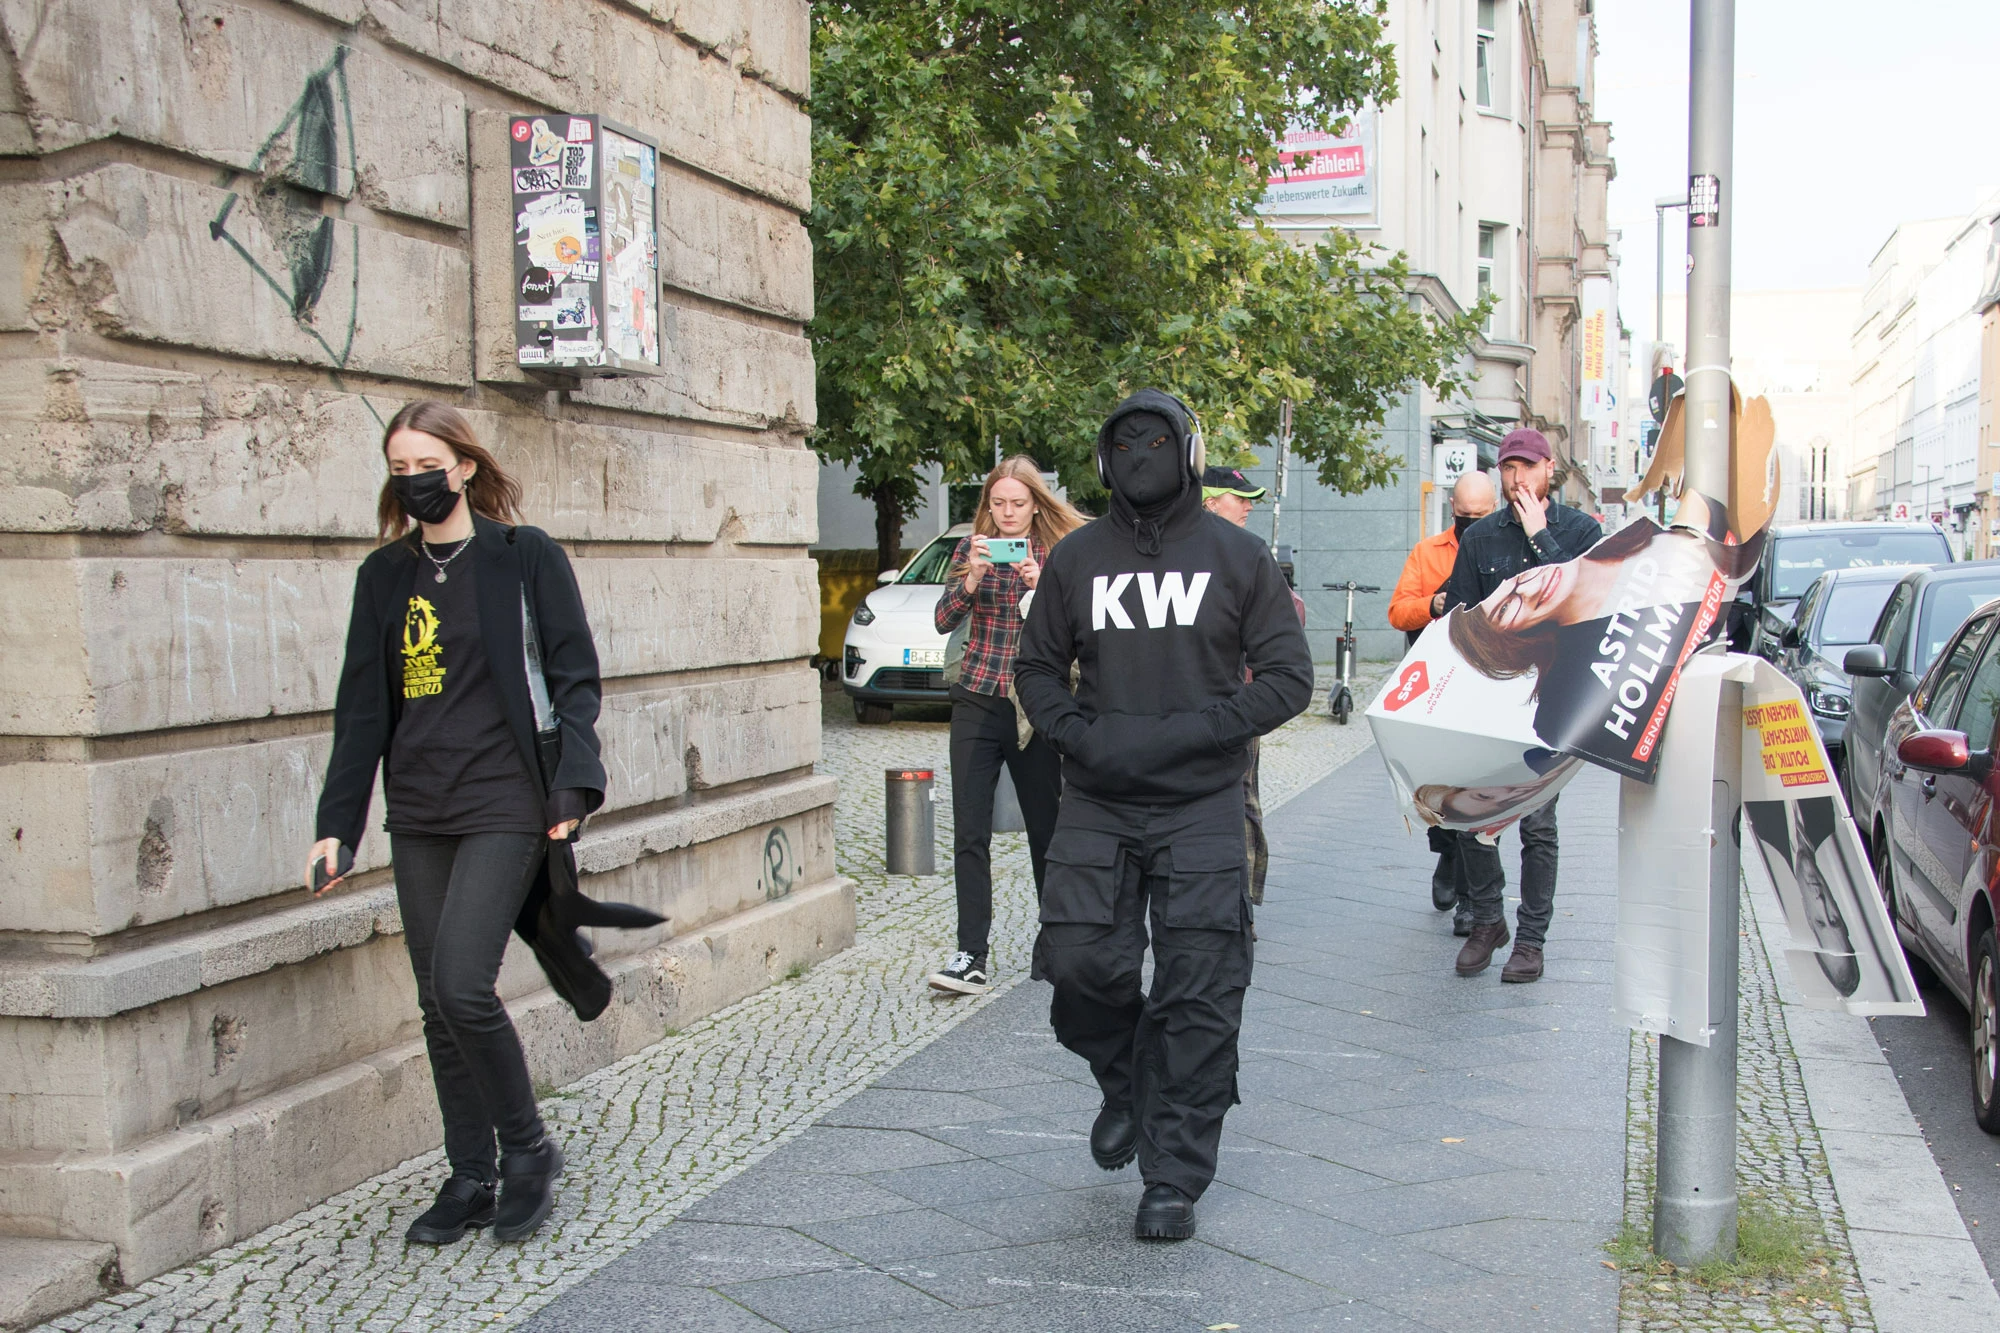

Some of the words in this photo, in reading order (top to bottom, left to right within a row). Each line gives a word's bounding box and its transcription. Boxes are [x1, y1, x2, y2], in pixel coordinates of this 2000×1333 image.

[566, 147, 583, 156] TOO
[565, 166, 578, 175] TO
[566, 156, 586, 167] SHY
[565, 175, 587, 186] RAP!
[1276, 187, 1330, 203] lebenswerte
[1332, 183, 1368, 198] Zukunft.
[1586, 319, 1593, 330] ES
[1585, 332, 1593, 353] GAB
[1595, 336, 1603, 349] ZU
[1585, 354, 1593, 371] NIE
[1595, 352, 1603, 379] MEHR
[1091, 571, 1212, 631] KW
[1590, 557, 1659, 690] ASTRID
[1638, 706, 1667, 757] GENAU
[1704, 579, 1724, 614] FÜR
[1397, 670, 1421, 702] SPD
[1427, 700, 1437, 714] SPD
[1766, 703, 1800, 724] MACHEN
[1762, 726, 1811, 747] WIRTSCHAFT
[1763, 753, 1776, 770] DIE
[1776, 750, 1810, 769] POLITIK,
